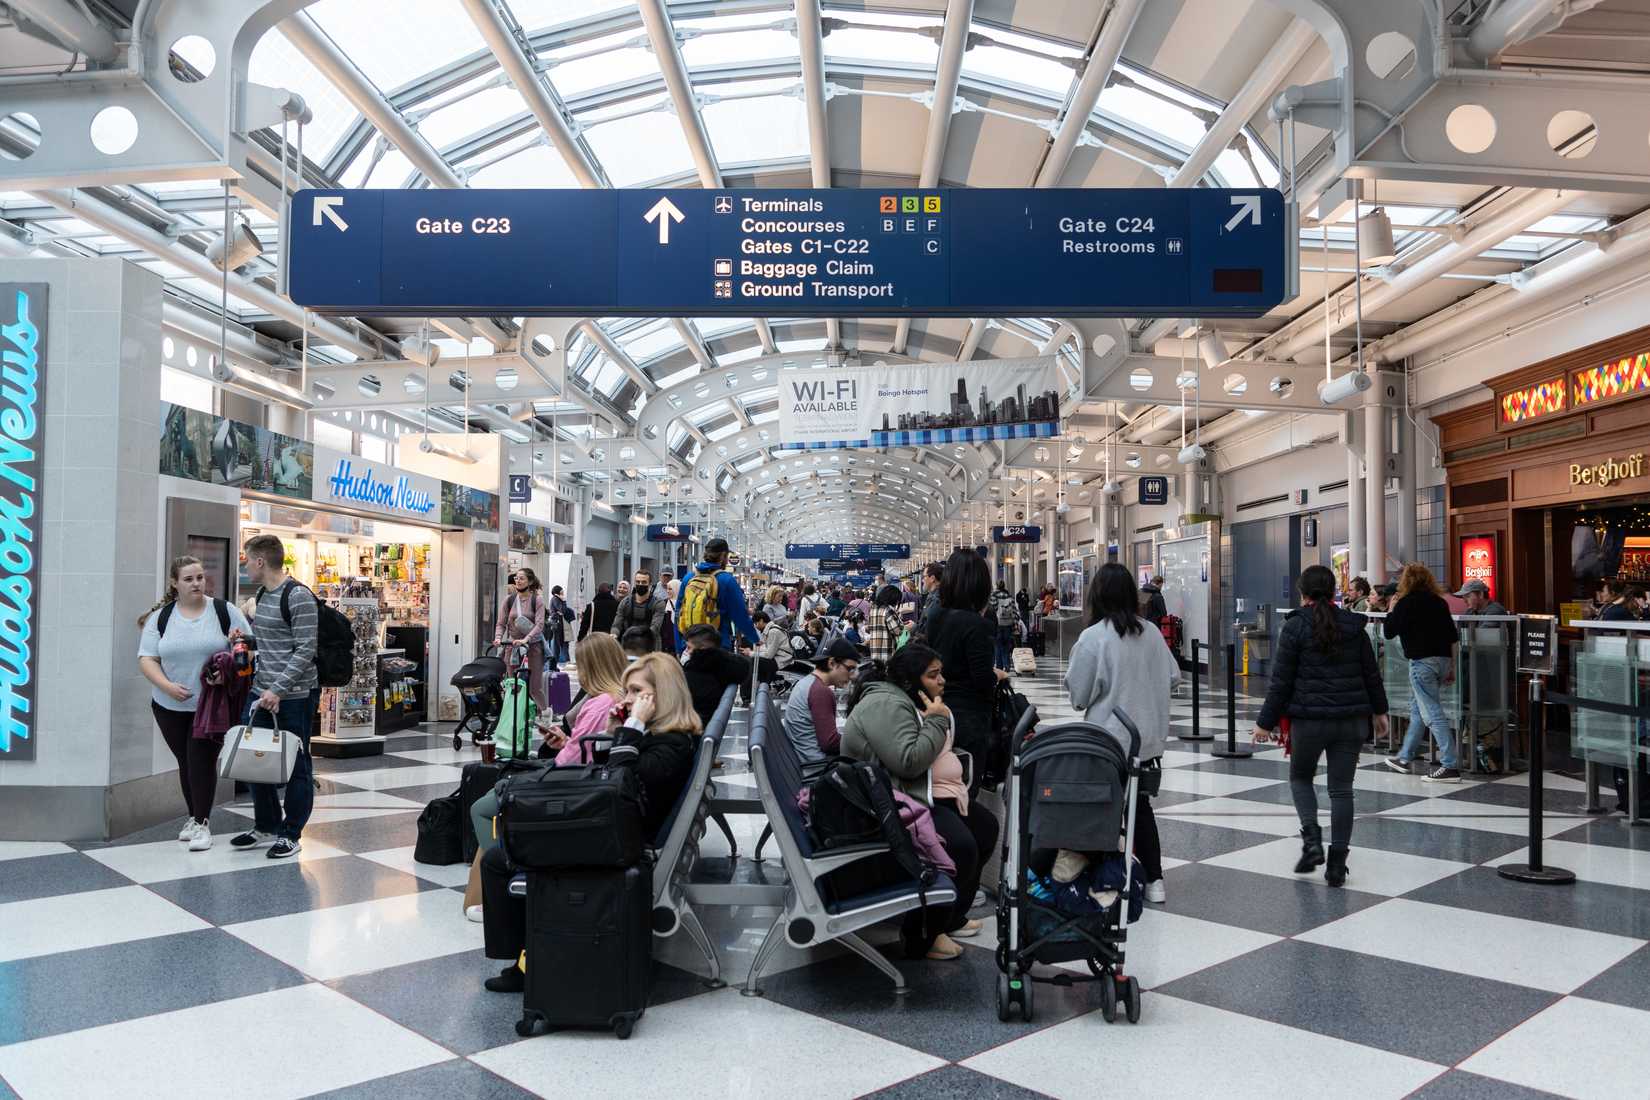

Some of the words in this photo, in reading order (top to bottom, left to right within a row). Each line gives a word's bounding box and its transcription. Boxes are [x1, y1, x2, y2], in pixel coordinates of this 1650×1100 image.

[741, 198, 823, 212] Terminals
[884, 199, 893, 210] 2
[906, 199, 915, 210] 3
[928, 199, 937, 210] 5
[416, 217, 463, 234] Gate
[471, 217, 511, 234] C23
[741, 218, 845, 233] Concourses
[883, 219, 894, 231] B
[906, 219, 915, 231] E
[927, 219, 937, 231] F
[1059, 217, 1107, 233] Gate
[1115, 217, 1155, 233] C24
[741, 239, 793, 254] Gates
[801, 239, 870, 254] C1-C22
[927, 240, 938, 253] C
[1063, 239, 1156, 253] Restrooms
[741, 261, 817, 277] Baggage
[826, 261, 874, 275] Claim
[741, 282, 804, 297] Ground
[812, 282, 894, 299] Transport
[0, 291, 39, 492] News
[792, 379, 857, 402] WI-FI
[793, 401, 858, 414] AVAILABLE
[1569, 452, 1644, 488] Berghoff
[330, 459, 394, 507] Hudson
[395, 476, 435, 513] News
[1008, 527, 1026, 536] C24
[1465, 566, 1493, 581] Berghoff
